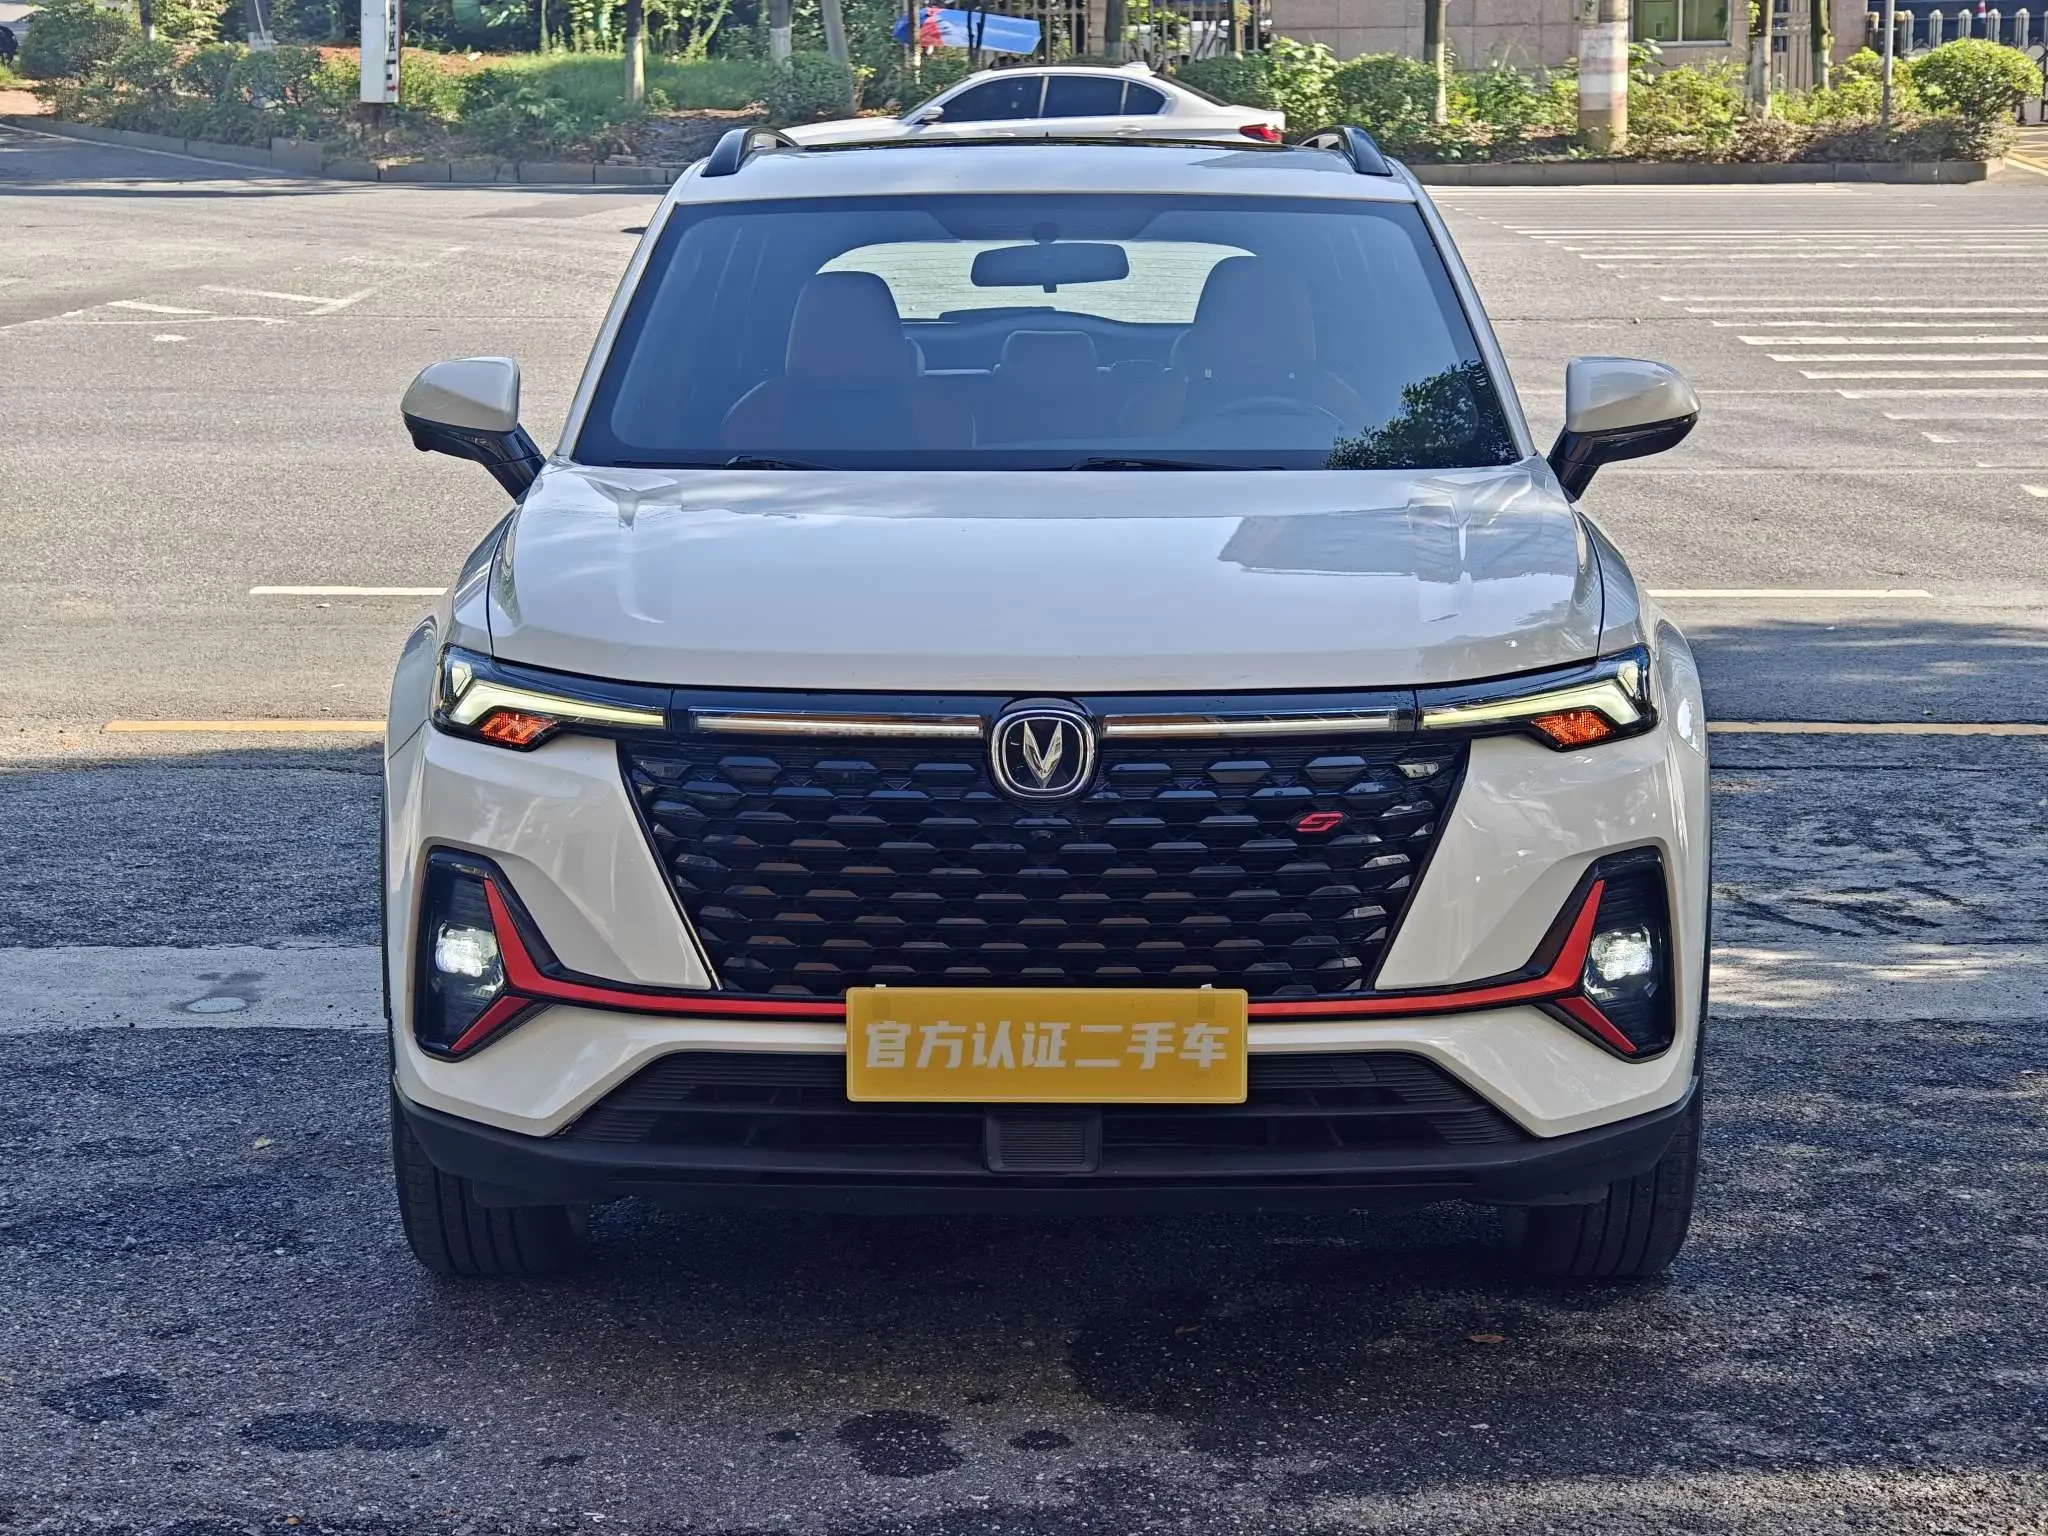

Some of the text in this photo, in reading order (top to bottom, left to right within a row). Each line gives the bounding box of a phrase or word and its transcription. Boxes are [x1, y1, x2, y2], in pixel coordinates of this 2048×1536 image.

[865, 1020, 1230, 1069] 官方认证二手车
